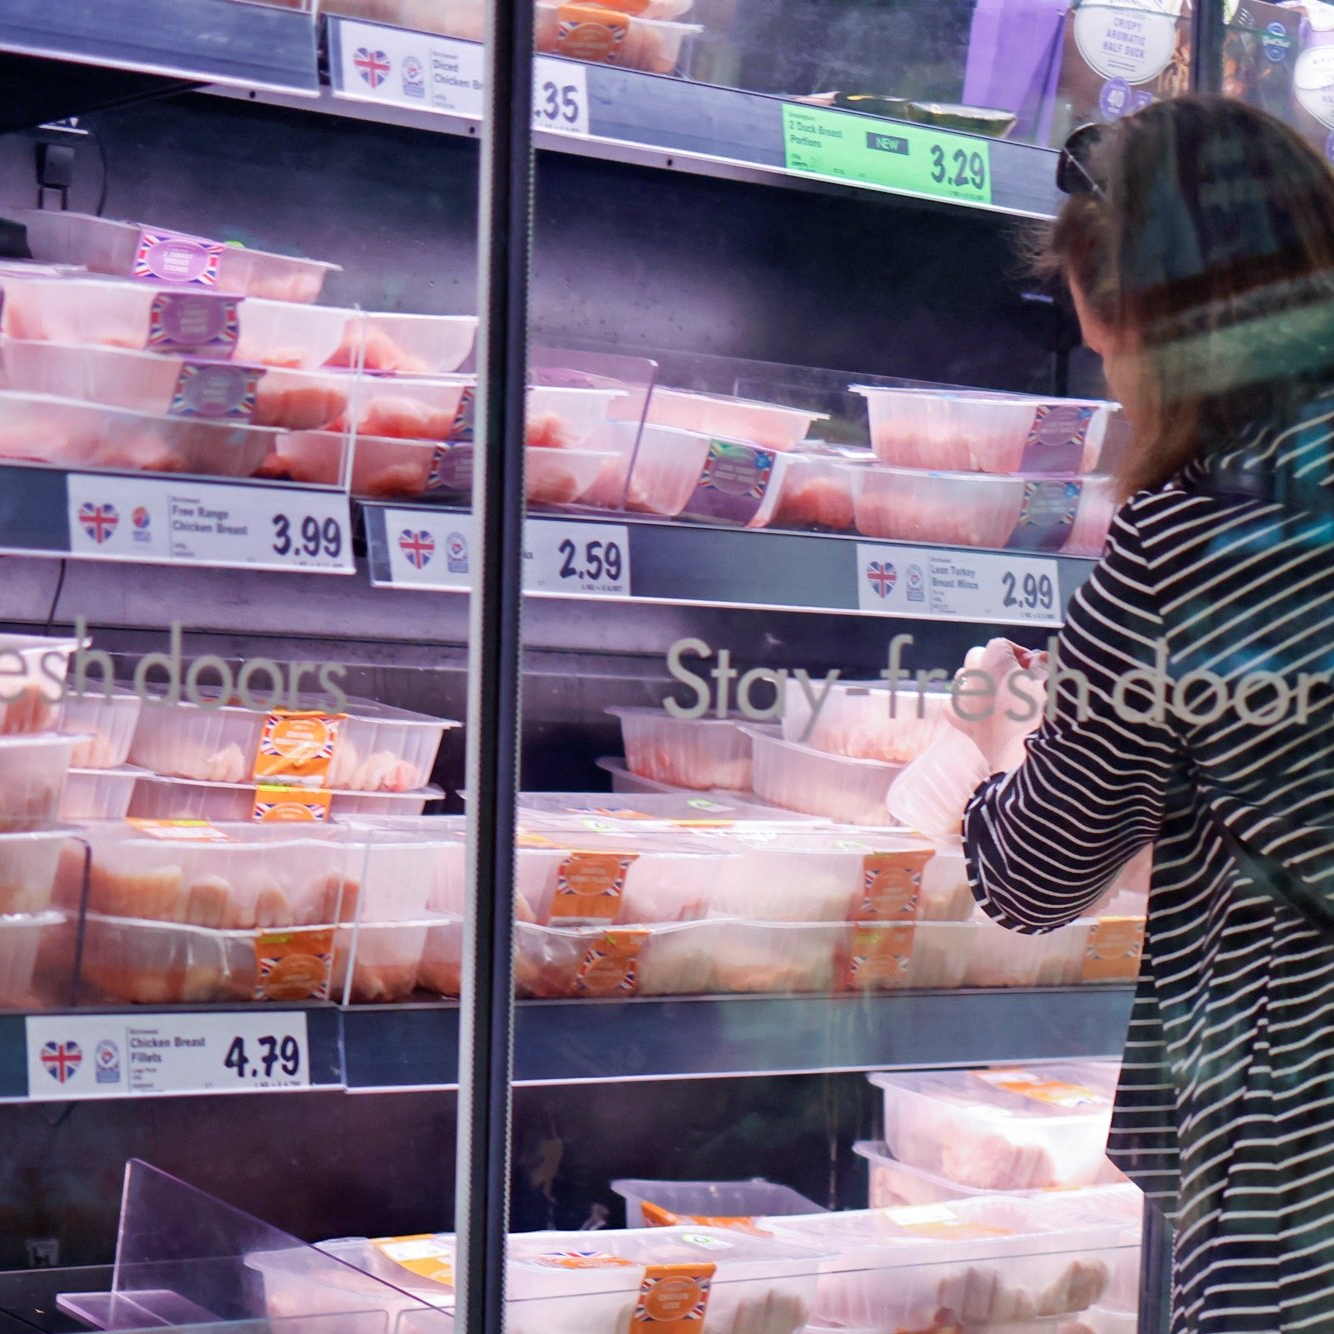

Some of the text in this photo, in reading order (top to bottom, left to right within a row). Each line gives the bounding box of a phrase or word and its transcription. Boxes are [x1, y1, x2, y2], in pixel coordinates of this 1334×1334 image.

[432, 59, 460, 74] Diced
[434, 74, 470, 88] Chicken
[534, 80, 579, 124] .35
[797, 121, 816, 134] Duck
[818, 125, 843, 138] Breast
[790, 134, 822, 149] Portions
[875, 136, 900, 151] NEW
[930, 143, 985, 190] 3.29
[172, 505, 230, 521] Free Range
[172, 520, 249, 536] Chicken Breast
[272, 512, 342, 558] 3.99
[558, 538, 623, 581] 2.59
[931, 563, 976, 579] Lean Turkey
[932, 577, 979, 590] Breast Mince
[1002, 571, 1054, 609] 2.99
[134, 621, 350, 715] doors
[130, 1036, 206, 1048] Chicken Breast
[131, 1052, 163, 1064] Fillets
[224, 1035, 301, 1079] 4.79
